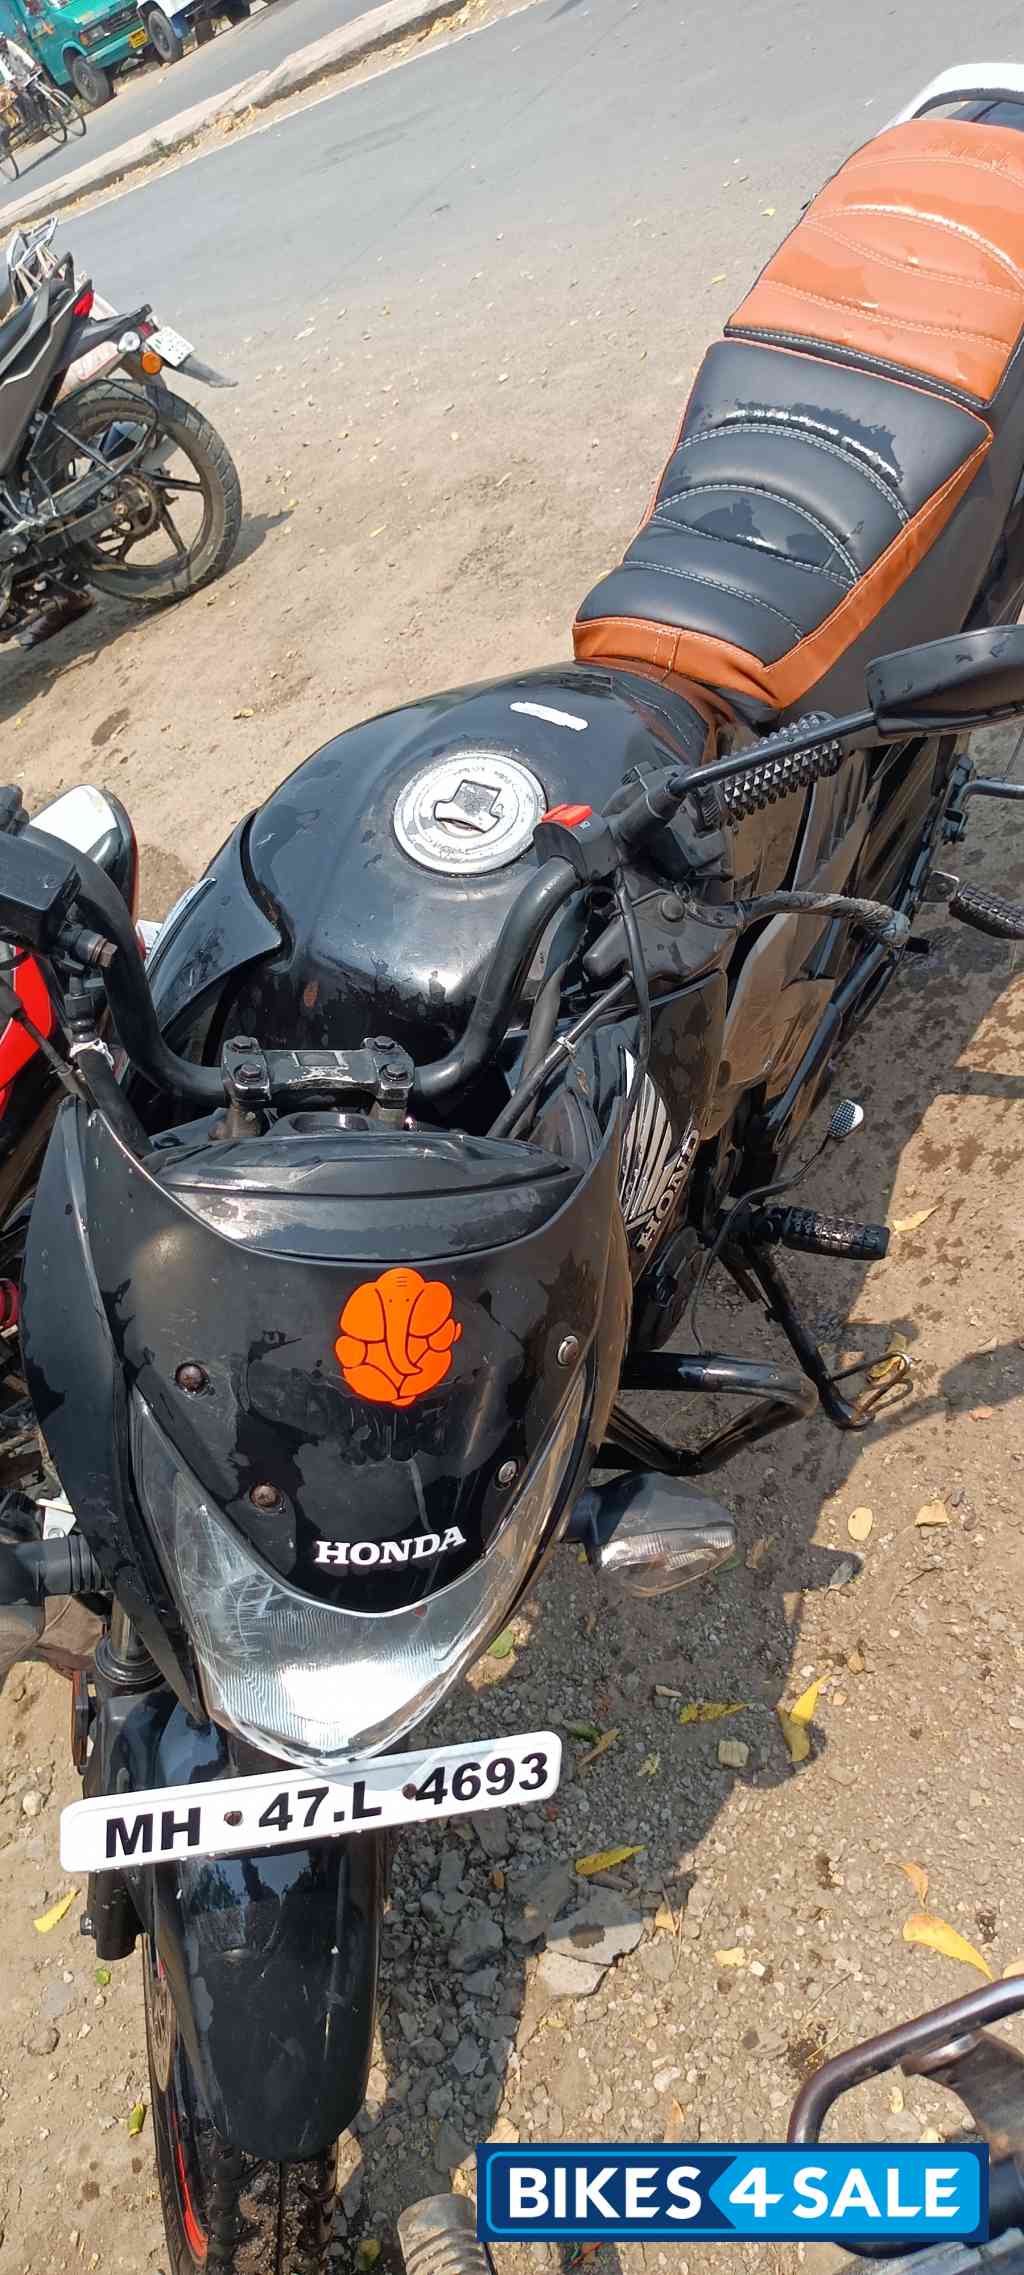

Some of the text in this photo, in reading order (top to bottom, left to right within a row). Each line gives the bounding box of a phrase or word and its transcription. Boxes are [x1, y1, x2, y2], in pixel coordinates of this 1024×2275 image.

[637, 1129, 699, 1252] HOND
[314, 1526, 467, 1566] HONDA
[105, 1807, 200, 1858] MH
[414, 1752, 548, 1806] 4693
